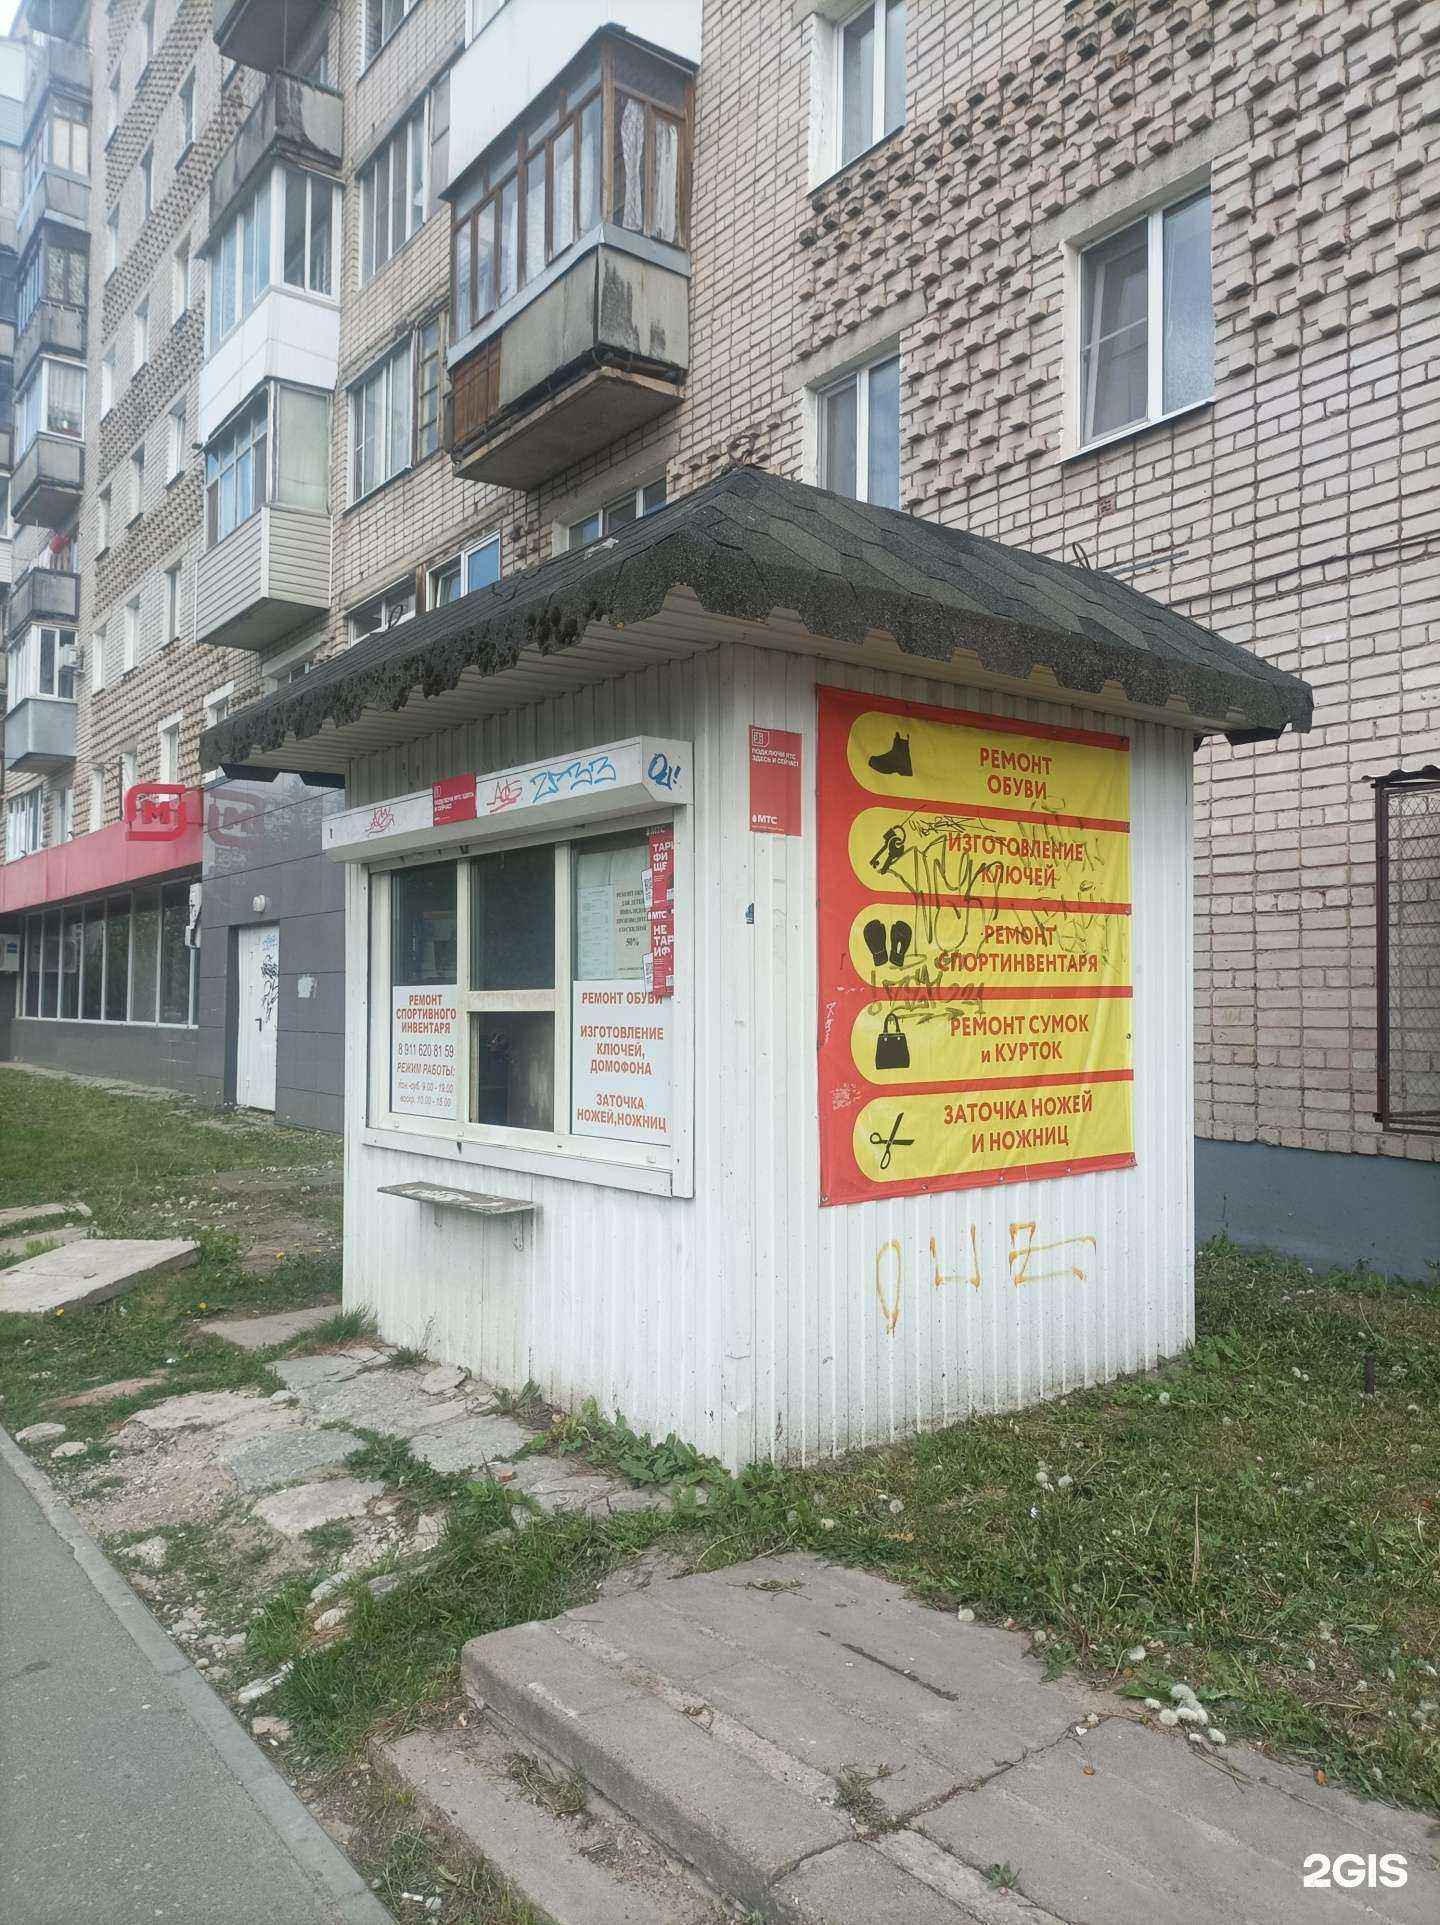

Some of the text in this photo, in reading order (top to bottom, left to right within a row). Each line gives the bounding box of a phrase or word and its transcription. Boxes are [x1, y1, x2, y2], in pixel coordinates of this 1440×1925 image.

[980, 748, 1052, 775] РЕМОНТ
[987, 774, 1047, 800] ОБУВИ
[757, 814, 778, 825] МТС
[948, 832, 1084, 862] ИЗГОТОВЛЕНИЕ
[653, 852, 668, 862] ФИ
[654, 862, 668, 872] ЩЕ
[981, 862, 1056, 887] КЛЮЧЕЙ
[652, 911, 667, 920] МТС
[653, 925, 667, 936] НЕ
[984, 924, 1056, 946] РЕМОНТ
[653, 935, 675, 947] ТАР
[653, 947, 671, 958] ИФ
[937, 951, 1098, 973] СПОРТИНВЕНТАРЯ
[409, 994, 442, 1006] РЕМОНТ
[582, 991, 663, 1005] РЕМОНТ ОБУВИ
[396, 1008, 457, 1020] СПОРТИВНОГО
[401, 1022, 451, 1034] ИНВЕНТАРЯ
[580, 1025, 664, 1040] ИЗГОТОВЛЕНИЕ
[950, 1014, 1089, 1037] РЕМОНТ СУМОК
[398, 1042, 454, 1059] 8 911 620 81 59
[597, 1042, 645, 1060] КЛЮЧЕЙ,
[981, 1040, 1063, 1063] и КУРТОК
[397, 1062, 455, 1077] РЕЖИМ РАБОТЫ:
[590, 1060, 652, 1076] ДОМОФОНА
[596, 1093, 645, 1110] ЗАТОЧКА
[943, 1089, 1093, 1125] ЗАТОЧКА НОЖЕЙ
[972, 1125, 1069, 1154] И НОЖНИЦ
